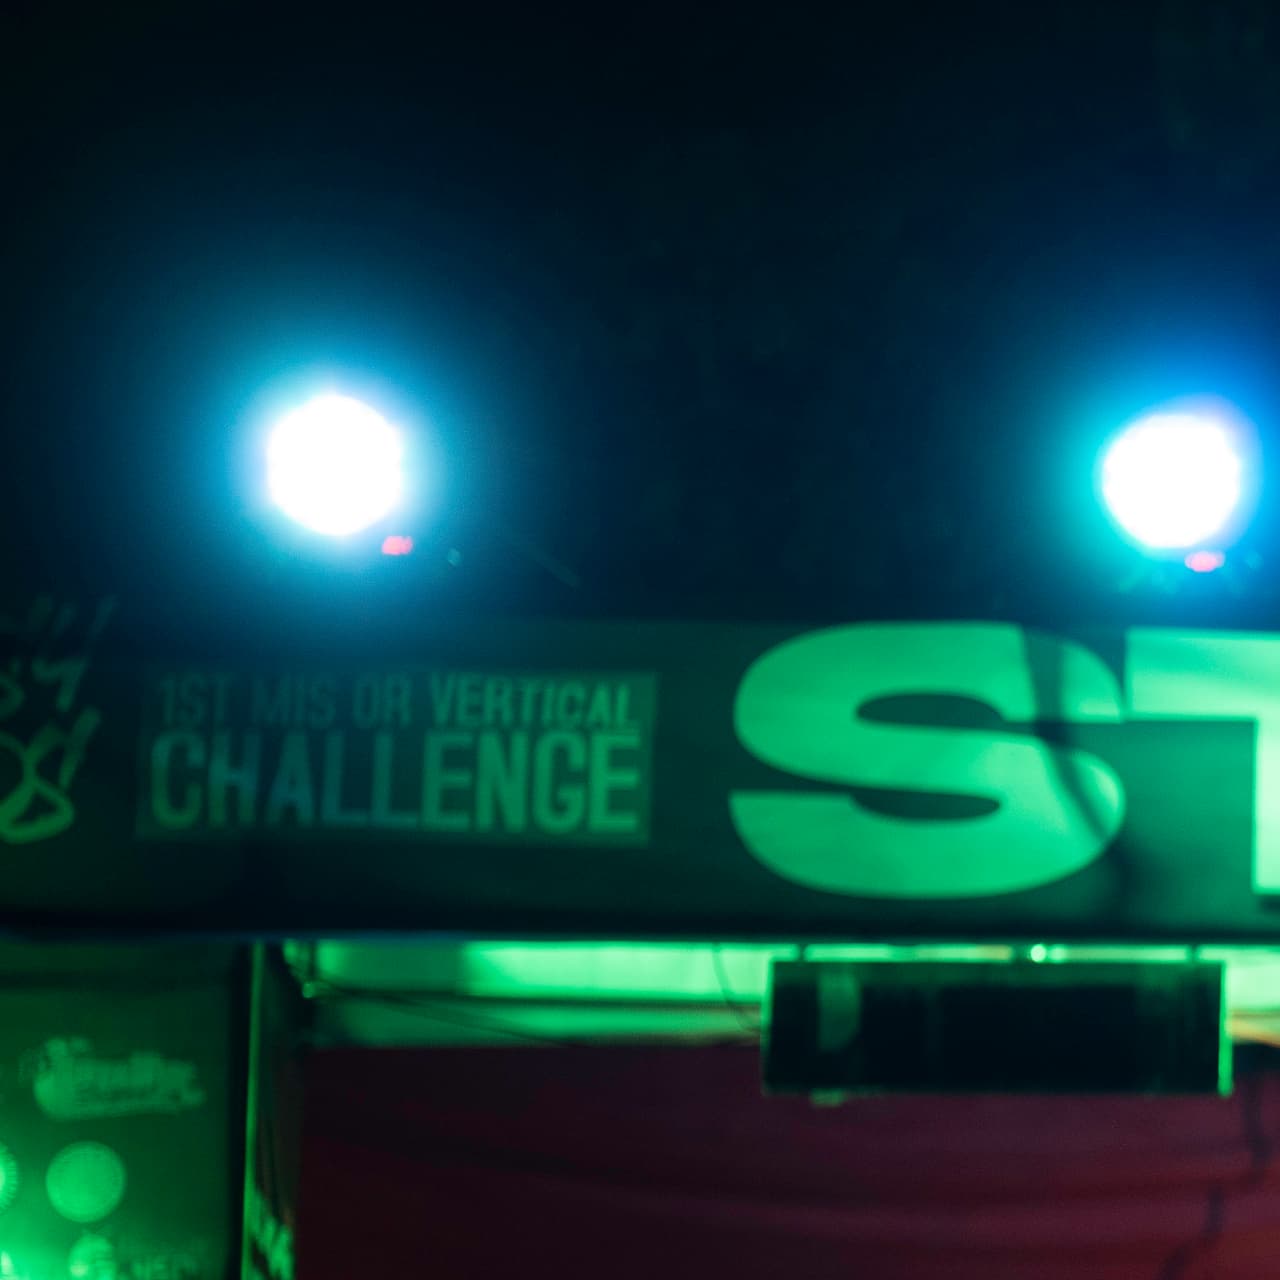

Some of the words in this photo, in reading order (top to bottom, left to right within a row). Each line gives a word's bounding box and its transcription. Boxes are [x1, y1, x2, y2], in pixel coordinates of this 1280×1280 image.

[160, 673, 231, 729] 1ST
[249, 673, 336, 729] MIS
[352, 673, 411, 729] OR
[429, 673, 640, 730] VERTICAL
[150, 729, 641, 834] CHALLENGE
